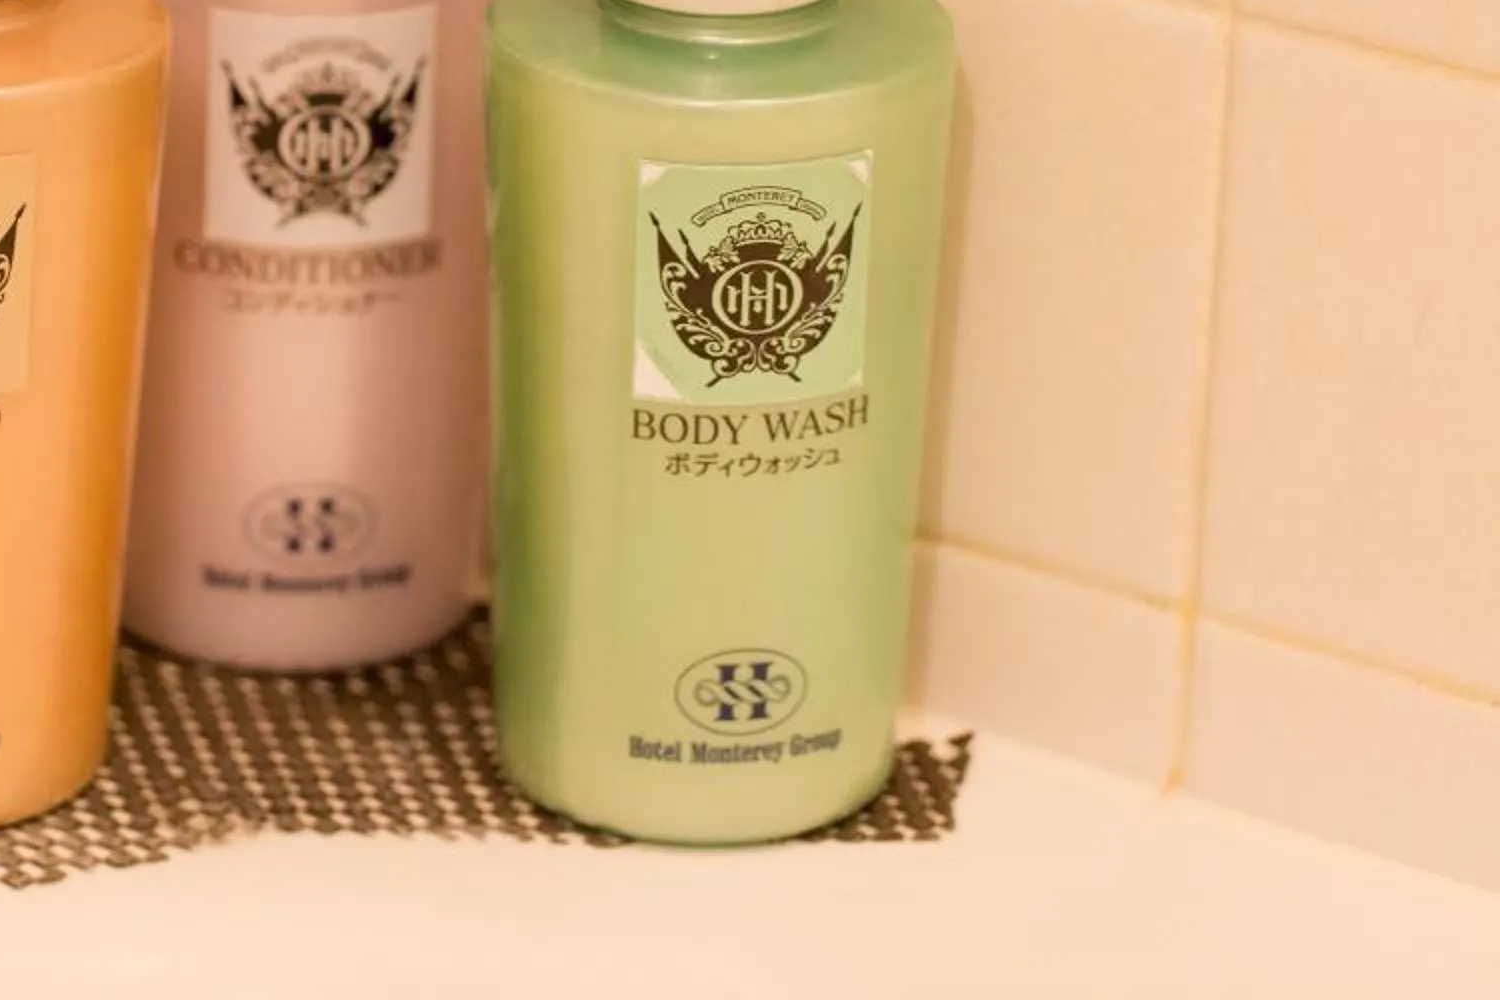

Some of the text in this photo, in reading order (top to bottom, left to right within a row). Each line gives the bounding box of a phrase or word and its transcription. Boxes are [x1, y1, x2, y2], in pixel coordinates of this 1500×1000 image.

[727, 190, 795, 206] MONTEREY
[631, 394, 870, 446] BODY WASH
[629, 728, 843, 766] Hotel Monterey Group
